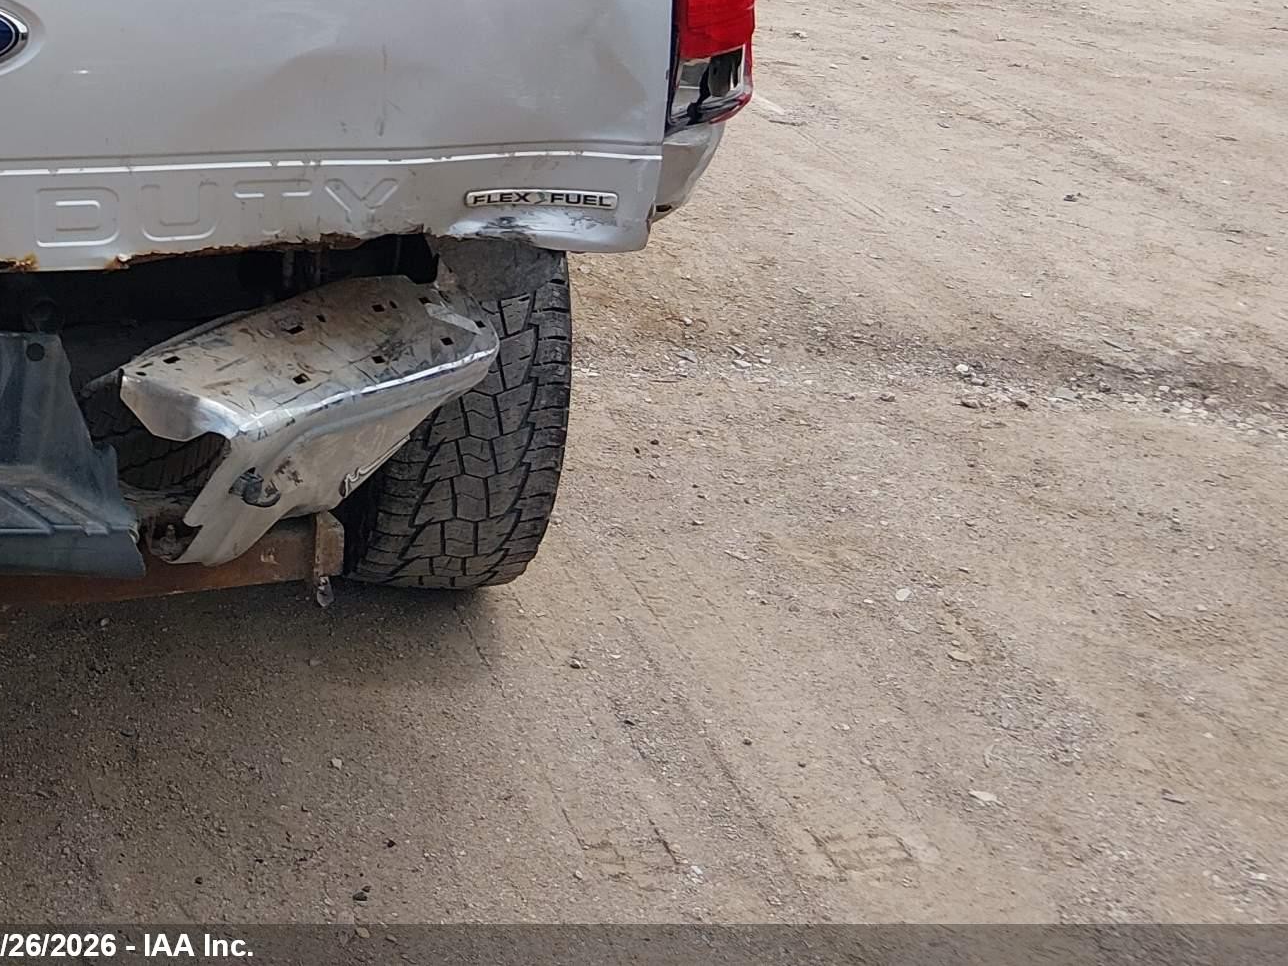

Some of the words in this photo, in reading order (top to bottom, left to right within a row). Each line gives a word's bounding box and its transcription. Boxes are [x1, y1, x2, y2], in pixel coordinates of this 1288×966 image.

[34, 178, 401, 249] DUTY
[473, 191, 531, 205] FLEX
[550, 192, 612, 207] FUEL
